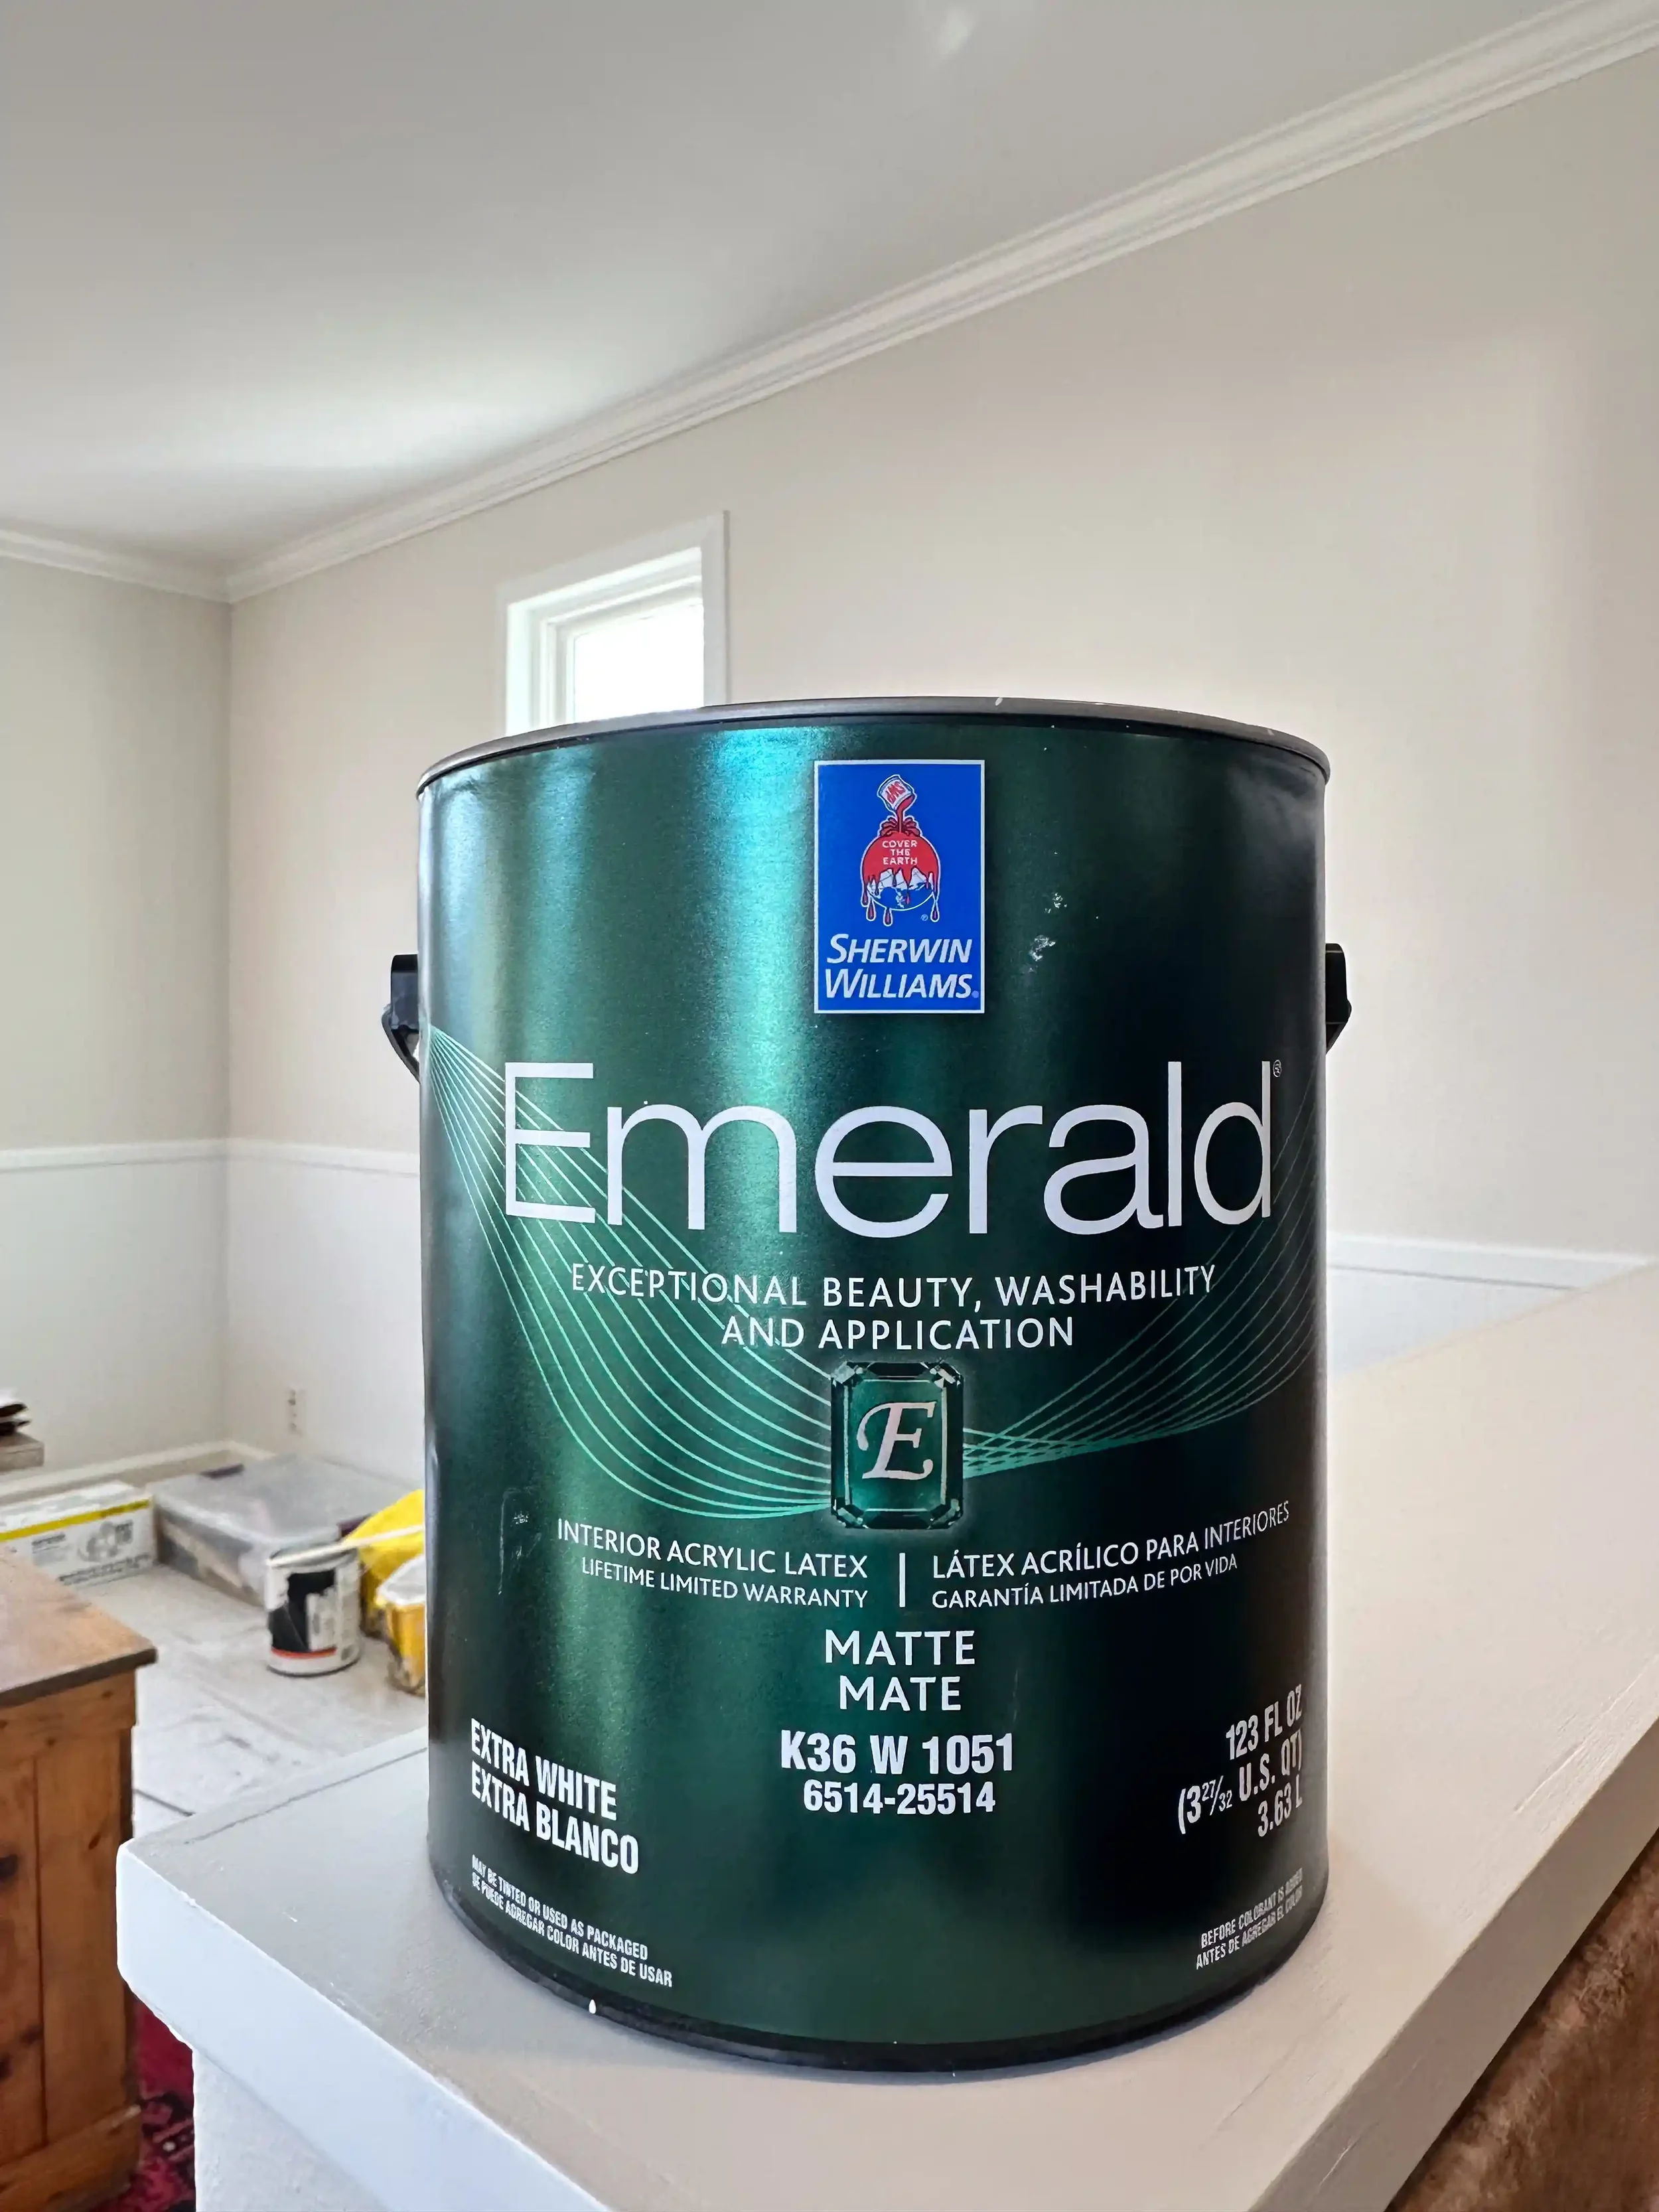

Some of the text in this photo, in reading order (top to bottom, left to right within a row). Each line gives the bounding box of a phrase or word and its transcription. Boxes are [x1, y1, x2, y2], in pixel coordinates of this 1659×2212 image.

[882, 840, 918, 848] COVER
[883, 857, 918, 865] EARTH
[827, 933, 972, 964] SHERWIN
[505, 1061, 1271, 1238] Emerald
[571, 1263, 1216, 1313] EXCEPTIONAL BEAUTY, WASHABILITY
[722, 1315, 1074, 1351] AND APPLICATION
[856, 1401, 937, 1481] E
[557, 1518, 868, 1579] INTERIOR ACRYLIC LATEX
[933, 1500, 1289, 1580] LÁTEX ACRÍLICO PARA INTERIORES
[581, 1556, 868, 1609] LIFETIME LIMITED WARRANTY
[932, 1552, 1238, 1609] GARANTÍA LIMITADA DE POR VIDA
[825, 1629, 975, 1666] MATTE
[839, 1675, 962, 1711] MATE
[1226, 1684, 1302, 1760] 123 FL OZ
[471, 1718, 617, 1820] EXTRA WHITE
[780, 1729, 1013, 1775] K36 W 1051
[1239, 1753, 1275, 1802] U.S.
[1281, 1728, 1302, 1776] QT)
[472, 1760, 639, 1874] EXTRA BLANCO
[803, 1779, 995, 1815] 6514-25514
[1258, 1774, 1303, 1837] 3.63 L
[498, 1876, 526, 1907] TINTED
[528, 1896, 541, 1916] OR
[543, 1904, 568, 1929] USED
[571, 1919, 584, 1937] AS
[587, 1925, 648, 1960] PACKAGED
[505, 1900, 545, 1937] AGREGAR
[547, 1925, 579, 1954] COLOR
[582, 1942, 618, 1969] ANTES
[620, 1956, 636, 1976] DE
[639, 1963, 672, 1987] USAR
[1201, 1919, 1236, 1949] BEFORE
[1238, 1891, 1276, 1930] COLORANT
[1196, 1943, 1226, 1970] ANTES
[1228, 1935, 1240, 1954] DE
